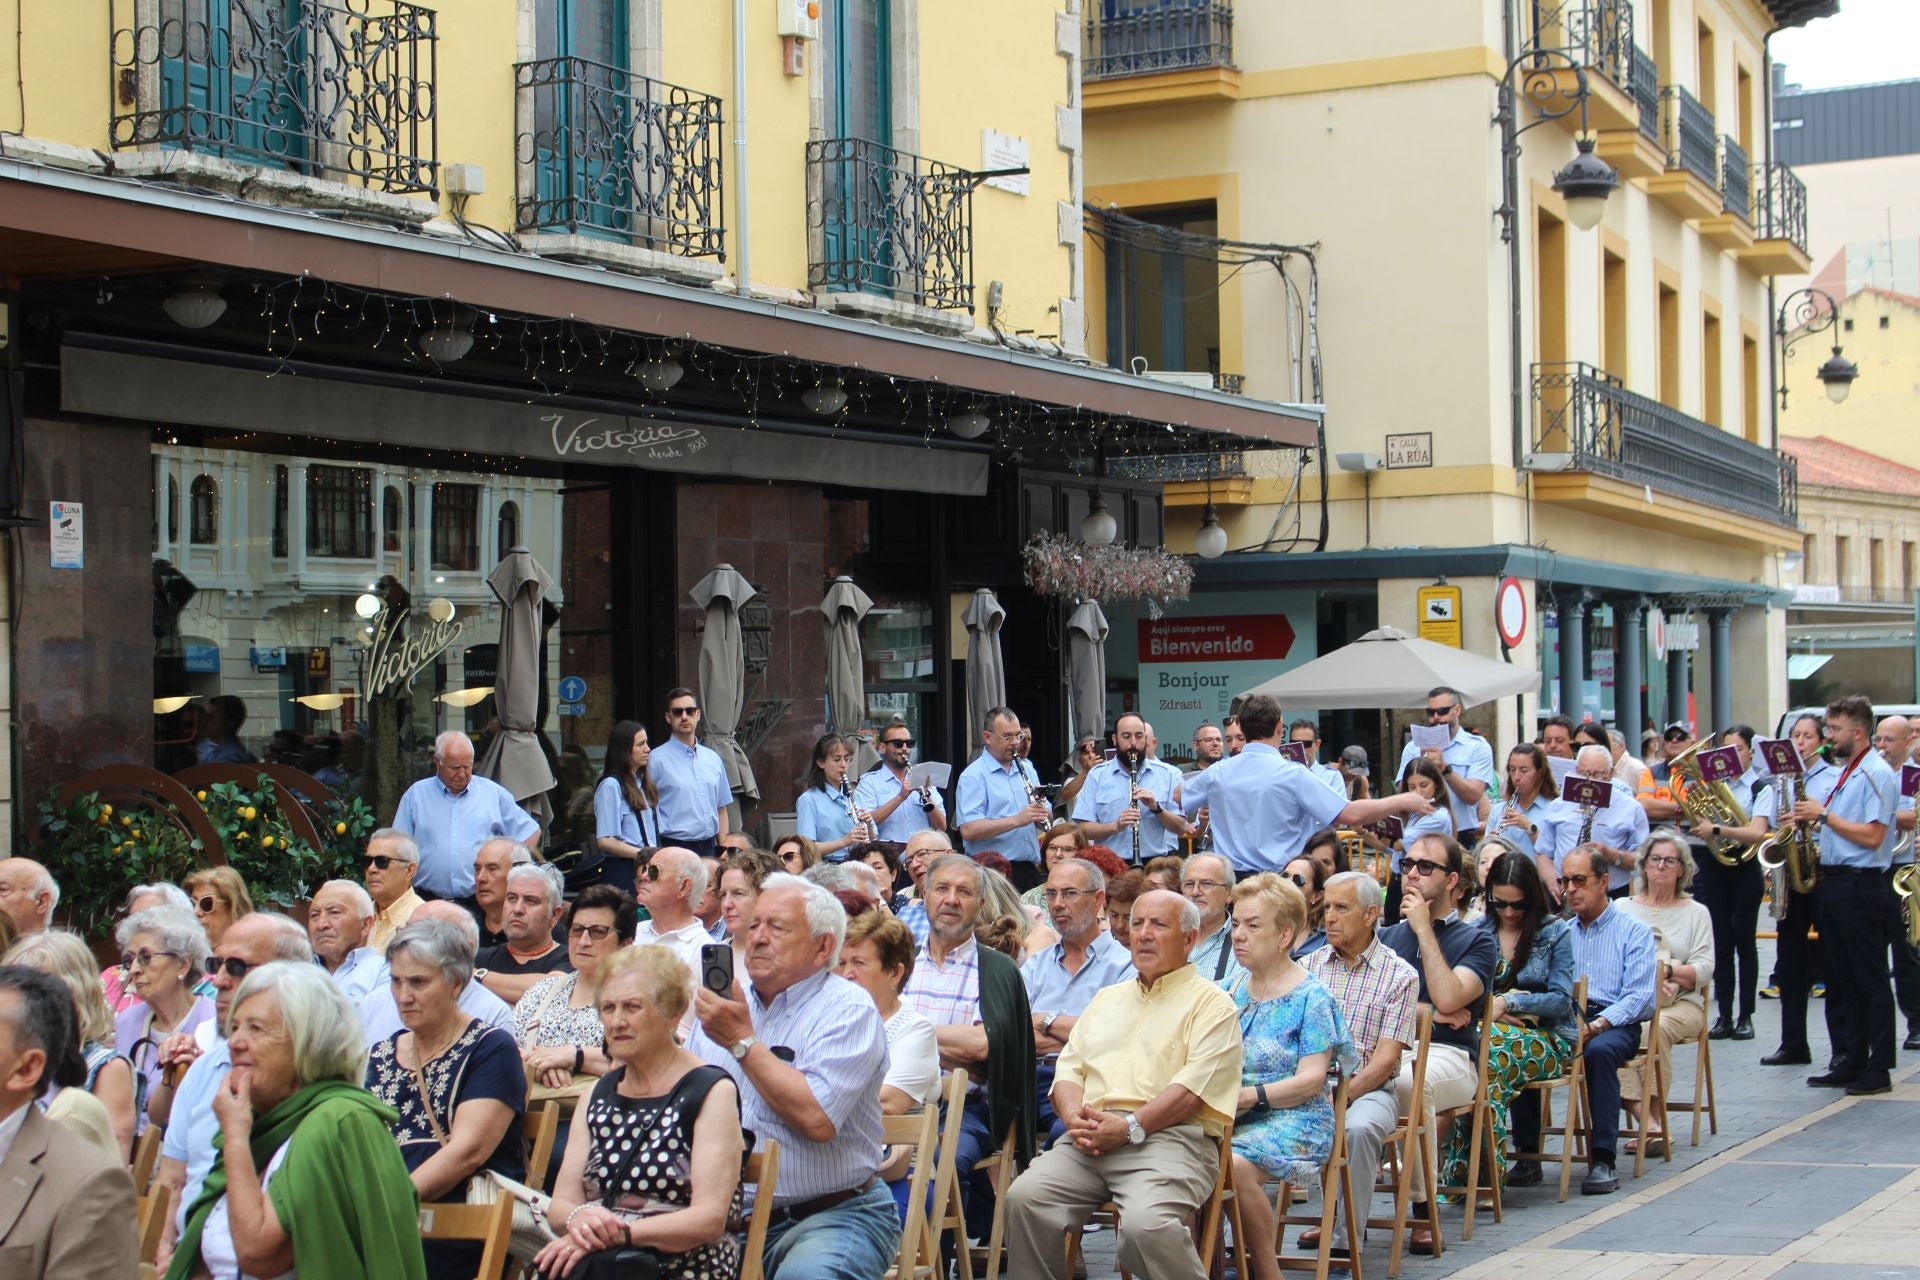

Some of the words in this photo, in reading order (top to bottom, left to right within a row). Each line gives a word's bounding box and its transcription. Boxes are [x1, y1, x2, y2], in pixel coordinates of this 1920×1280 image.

[540, 414, 700, 455] Victoria
[1400, 439, 1418, 447] CALLE
[649, 446, 683, 460] desde
[1390, 451, 1404, 464] LA
[1407, 447, 1429, 463] RÚA
[1172, 625, 1206, 635] siempre
[1207, 624, 1226, 633] eres
[1151, 636, 1254, 655] Bienvenido
[366, 607, 463, 703] Victoria
[1158, 671, 1230, 691] Bonjour
[1159, 699, 1202, 710] Zdrasti
[1163, 743, 1193, 760] Hallo
